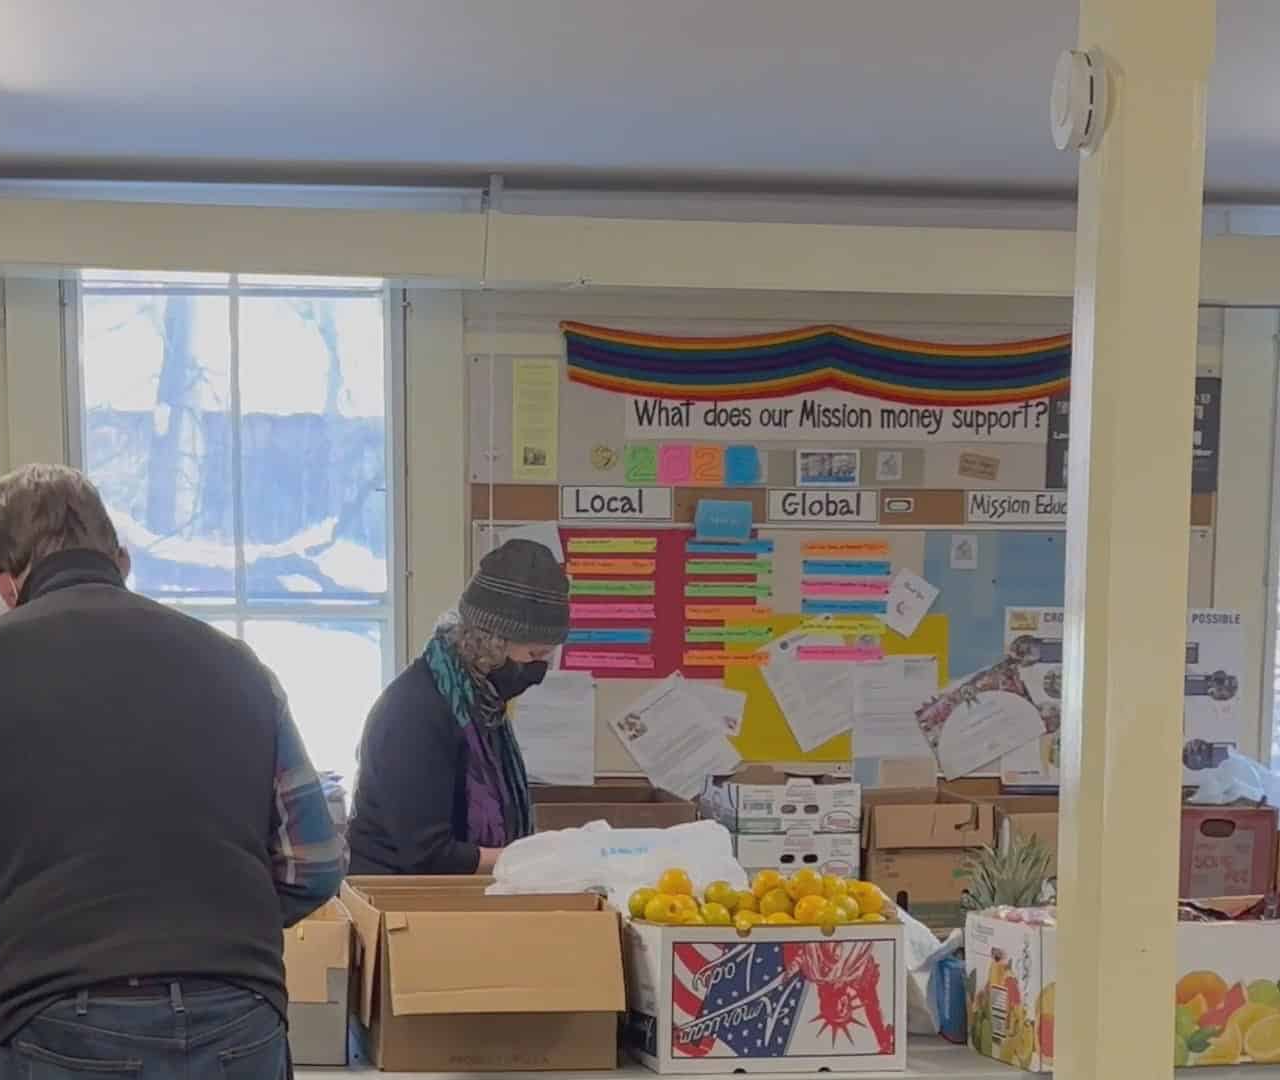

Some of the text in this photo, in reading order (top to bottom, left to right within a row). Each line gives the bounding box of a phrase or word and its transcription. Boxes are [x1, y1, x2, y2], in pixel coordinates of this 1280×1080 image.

[633, 399, 1049, 434] What does our Mission money support?
[575, 488, 644, 514] Local
[782, 491, 861, 518] Global
[969, 491, 1067, 519] Mission Educ
[1043, 612, 1240, 625] CRO POSSIBLE
[679, 976, 799, 1047] American
